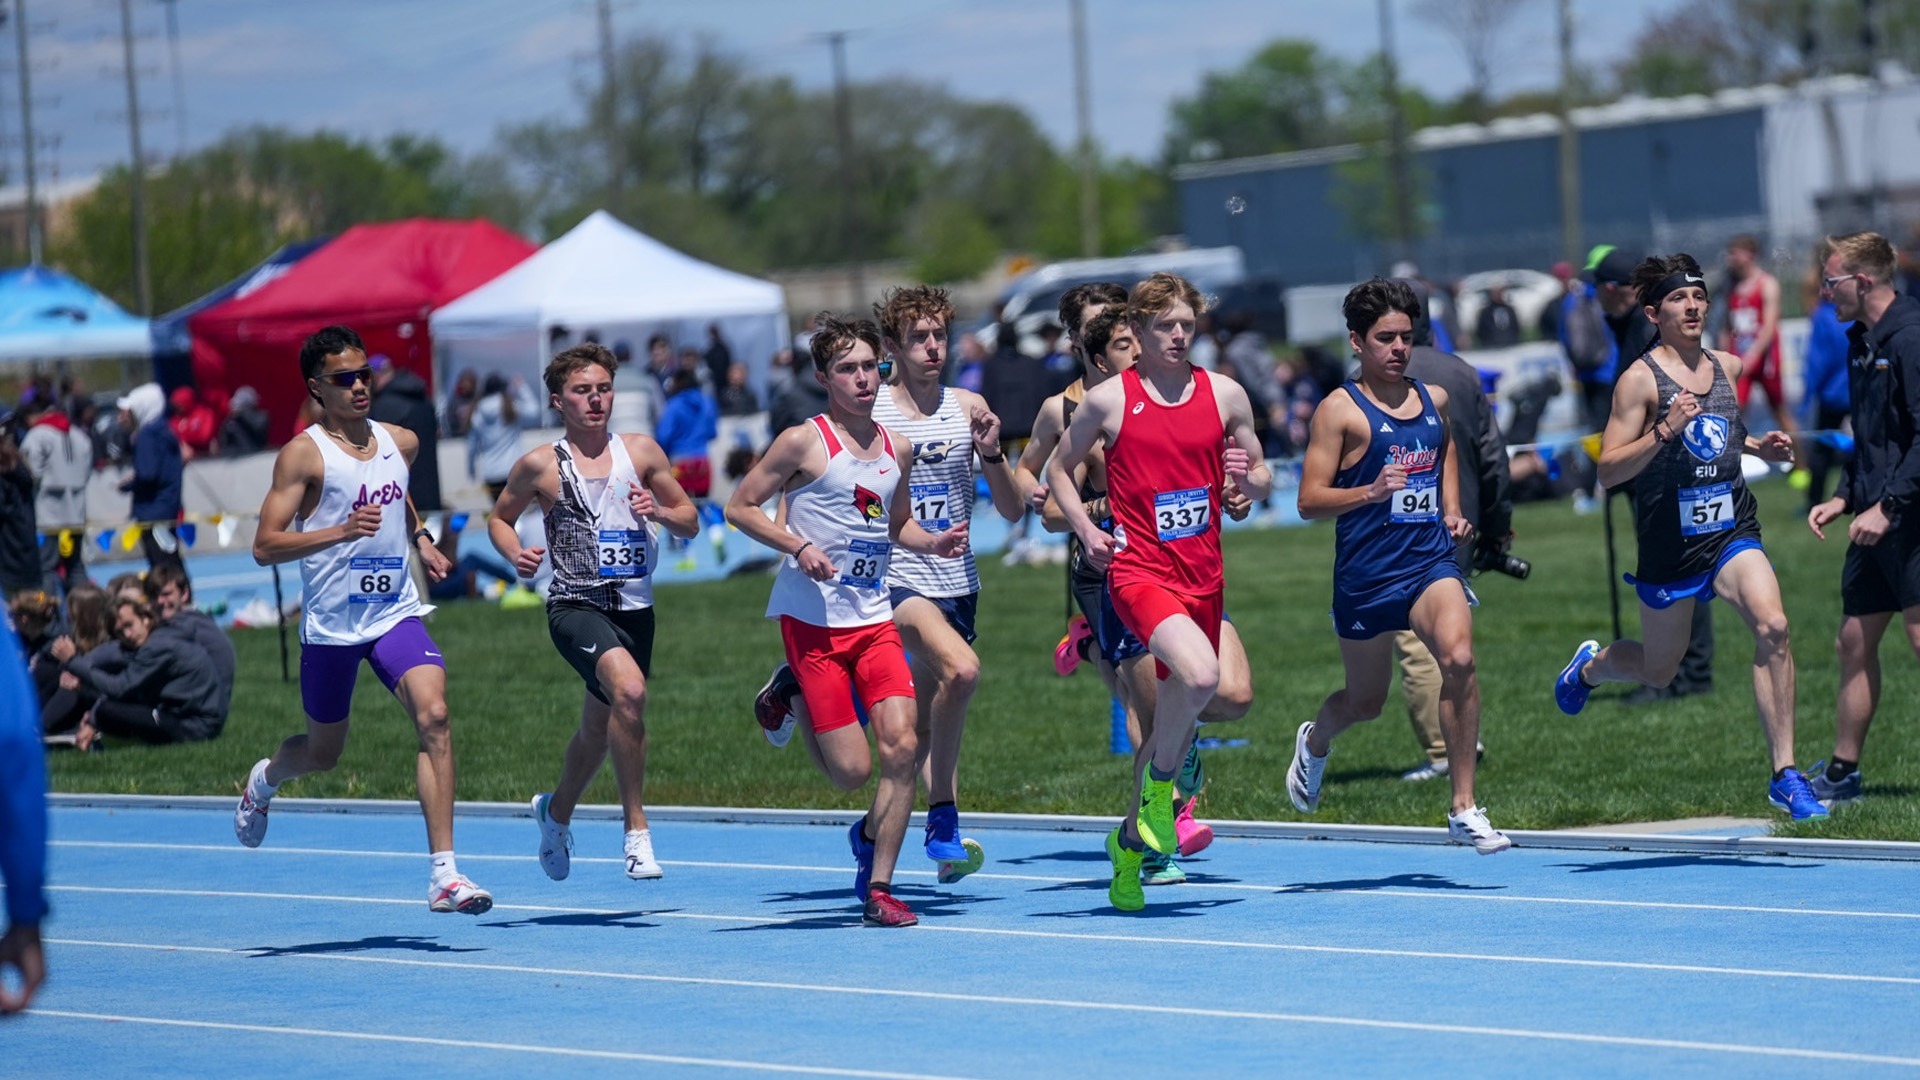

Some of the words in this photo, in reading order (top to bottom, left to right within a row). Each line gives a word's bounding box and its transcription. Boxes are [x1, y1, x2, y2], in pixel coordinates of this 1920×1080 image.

[1695, 464, 1718, 478] EIU
[912, 500, 946, 520] 17
[1402, 493, 1431, 514] 94
[1691, 501, 1723, 525] 57
[1158, 504, 1208, 530] 337
[601, 547, 646, 566] 335
[851, 558, 878, 578] 83
[360, 574, 391, 594] 68
